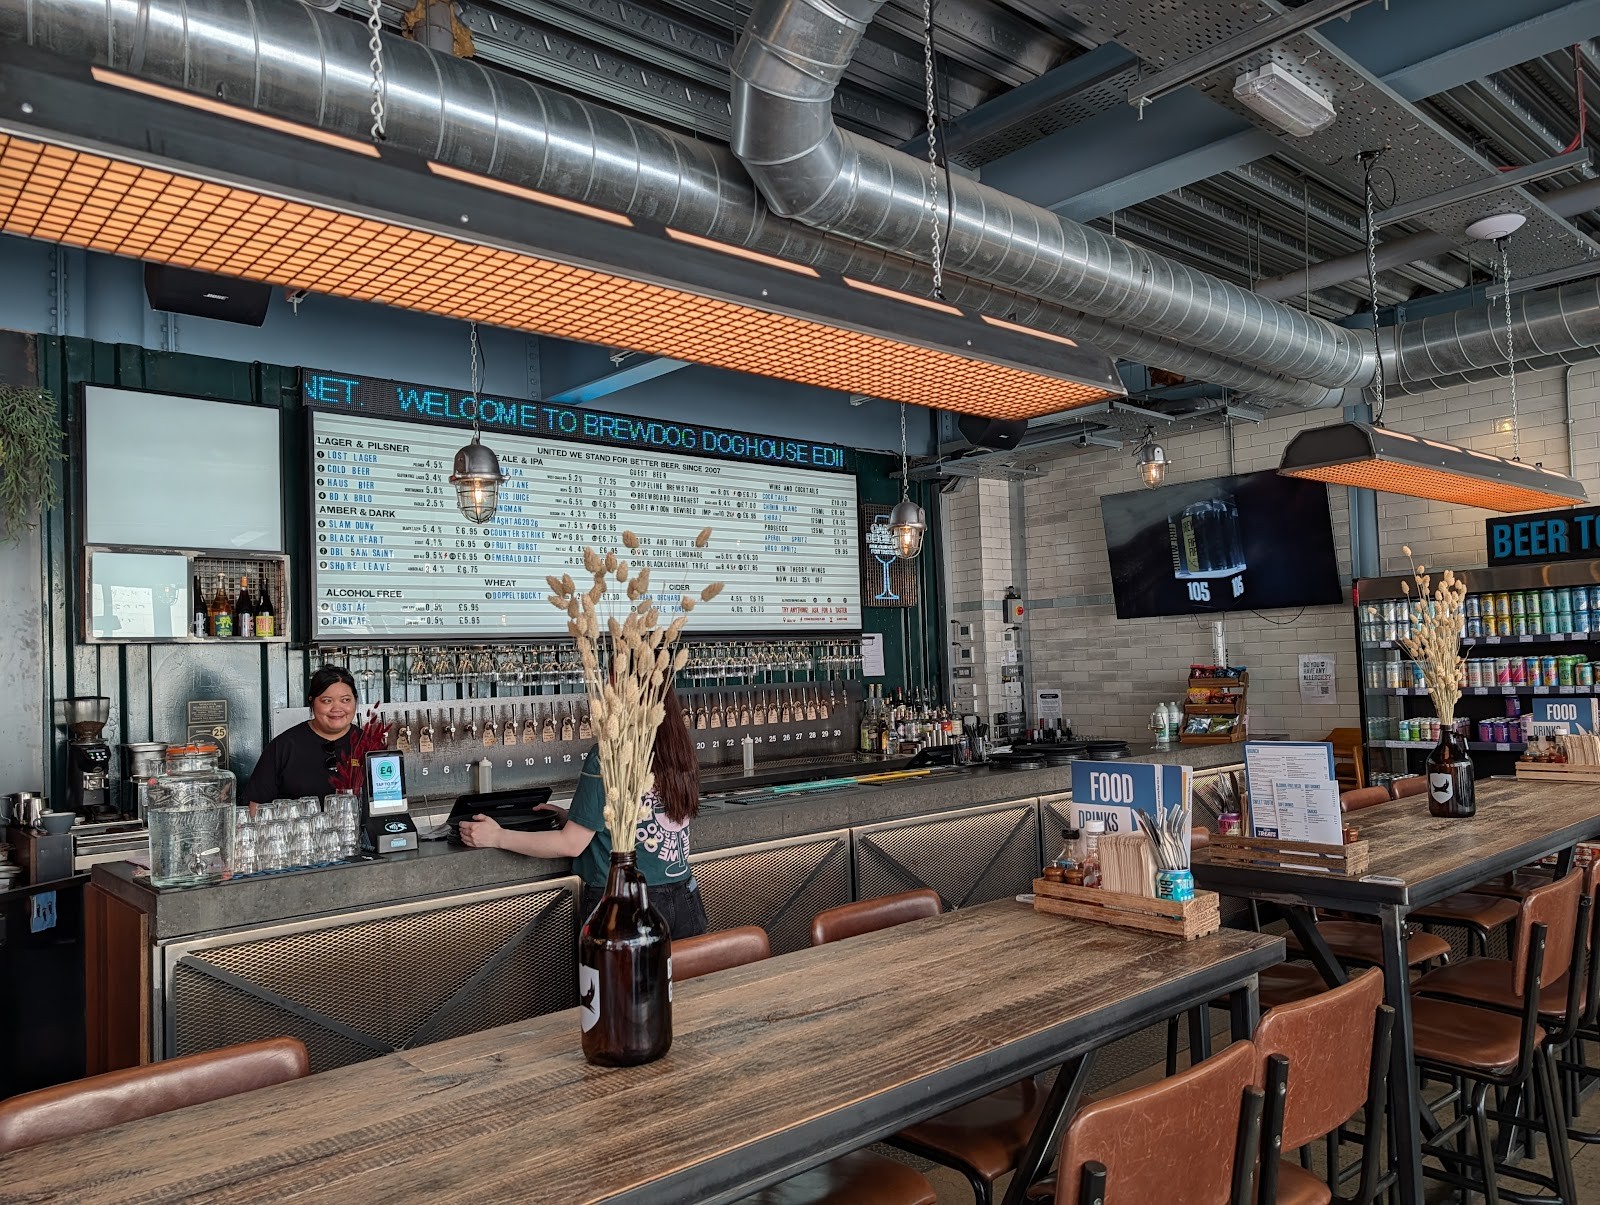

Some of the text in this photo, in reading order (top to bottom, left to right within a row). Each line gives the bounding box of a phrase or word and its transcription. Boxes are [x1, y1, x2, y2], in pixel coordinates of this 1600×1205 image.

[396, 387, 536, 428] WELCOME
[542, 408, 577, 432] TO
[584, 414, 696, 448] BREWDOG
[702, 431, 808, 463] DOGHOUSE
[318, 436, 352, 447] LAGER
[368, 442, 410, 452] PILSNER
[328, 451, 348, 460] LOST
[354, 454, 378, 462] LAGER
[502, 455, 518, 463] ALE
[538, 448, 568, 456] UNITED
[586, 453, 610, 462] STAND
[612, 456, 628, 464] FOR
[630, 458, 658, 468] BETTER
[682, 464, 702, 472] SINCE
[328, 464, 346, 474] COLD
[352, 467, 370, 476] BEER
[630, 469, 647, 478] GUEST
[328, 479, 348, 488] HAUS
[358, 481, 374, 490] BIER
[330, 492, 338, 500] BD
[344, 493, 348, 501] X
[354, 494, 372, 502] BRLO
[513, 493, 530, 501] JUICE
[320, 506, 357, 515] AMBER
[369, 509, 396, 518] DARK
[329, 520, 351, 528] SLAM
[356, 522, 374, 530] DUNK
[330, 534, 354, 542] BLACK
[359, 536, 384, 544] HEART
[1492, 514, 1600, 559] BEER T
[492, 541, 538, 551] FRUIT BURST
[330, 548, 344, 556] DBL
[350, 548, 368, 557] 5AM
[372, 549, 394, 558] SAINT
[652, 549, 673, 558] COFFEE
[492, 554, 541, 563] EMERALD DAZE
[330, 561, 357, 570] SHORE
[364, 562, 390, 572] LEAVE
[484, 579, 516, 587] WHEAT
[326, 588, 376, 598] ALCOHOL
[1187, 582, 1211, 602] 105
[332, 602, 352, 611] LOST
[356, 603, 366, 611] AF
[458, 603, 480, 612] £5.95
[332, 616, 353, 625] PUNK
[356, 617, 366, 625] AF
[1546, 704, 1578, 720] FOOD
[214, 728, 225, 736] 25
[524, 758, 534, 766] 10
[380, 766, 392, 774] £4
[1090, 772, 1134, 804] FOOD
